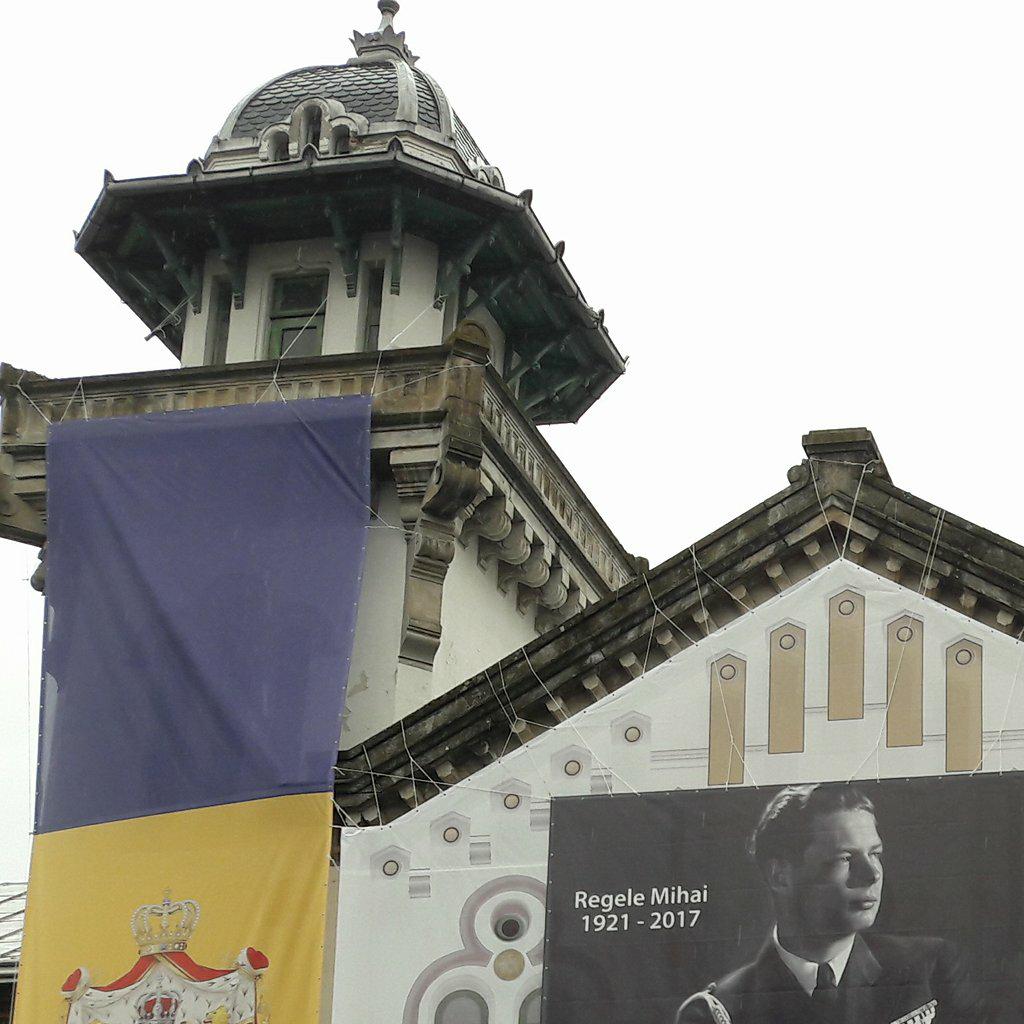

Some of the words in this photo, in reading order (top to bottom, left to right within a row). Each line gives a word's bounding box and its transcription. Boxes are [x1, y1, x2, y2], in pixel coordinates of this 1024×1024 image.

[574, 888, 645, 912] Regele
[651, 885, 708, 905] Mihai
[582, 913, 629, 932] 1921
[650, 910, 701, 930] 2017
